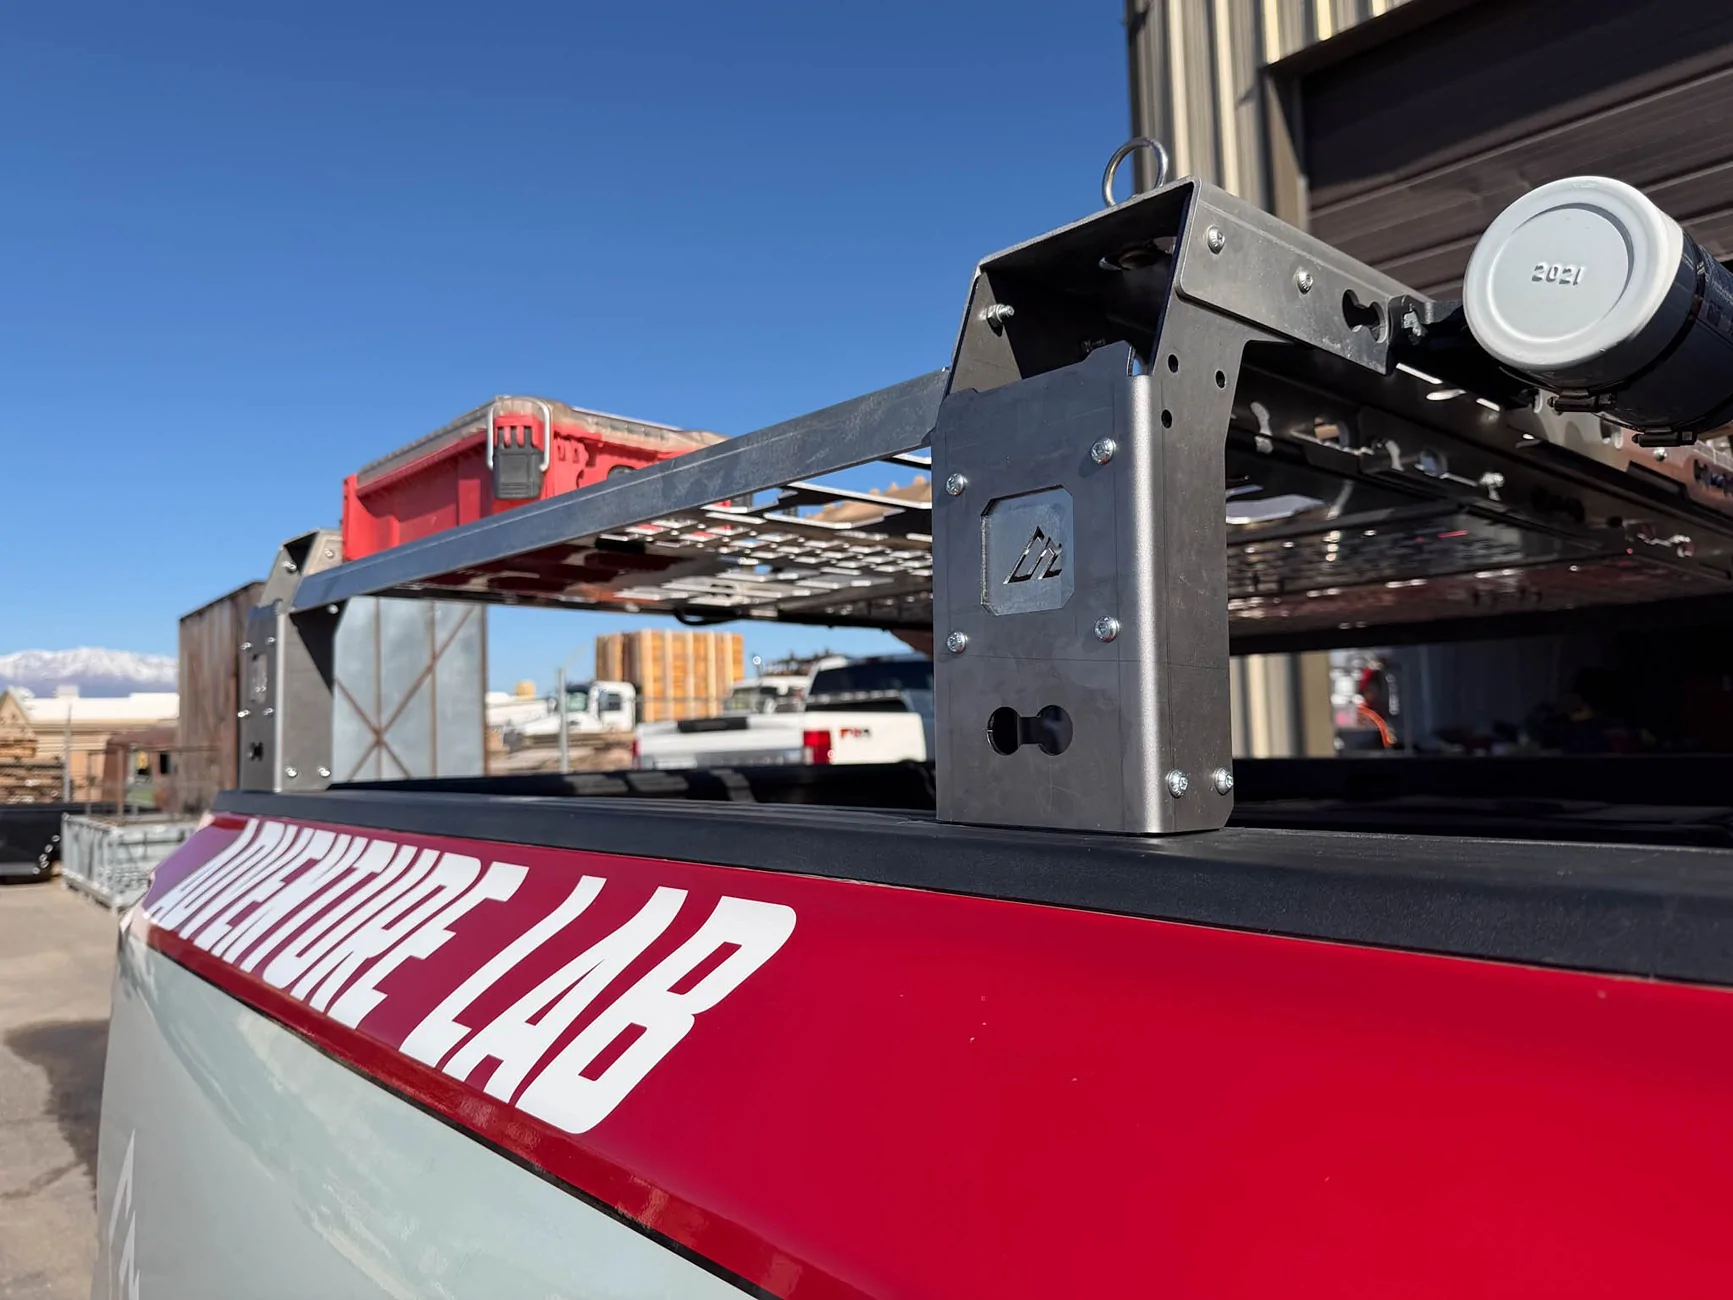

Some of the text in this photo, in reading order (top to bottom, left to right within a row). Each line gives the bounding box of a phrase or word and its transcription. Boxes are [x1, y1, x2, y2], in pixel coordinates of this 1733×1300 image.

[1531, 263, 1583, 286] 2021
[145, 818, 797, 1134] ADVENTURE LAB
